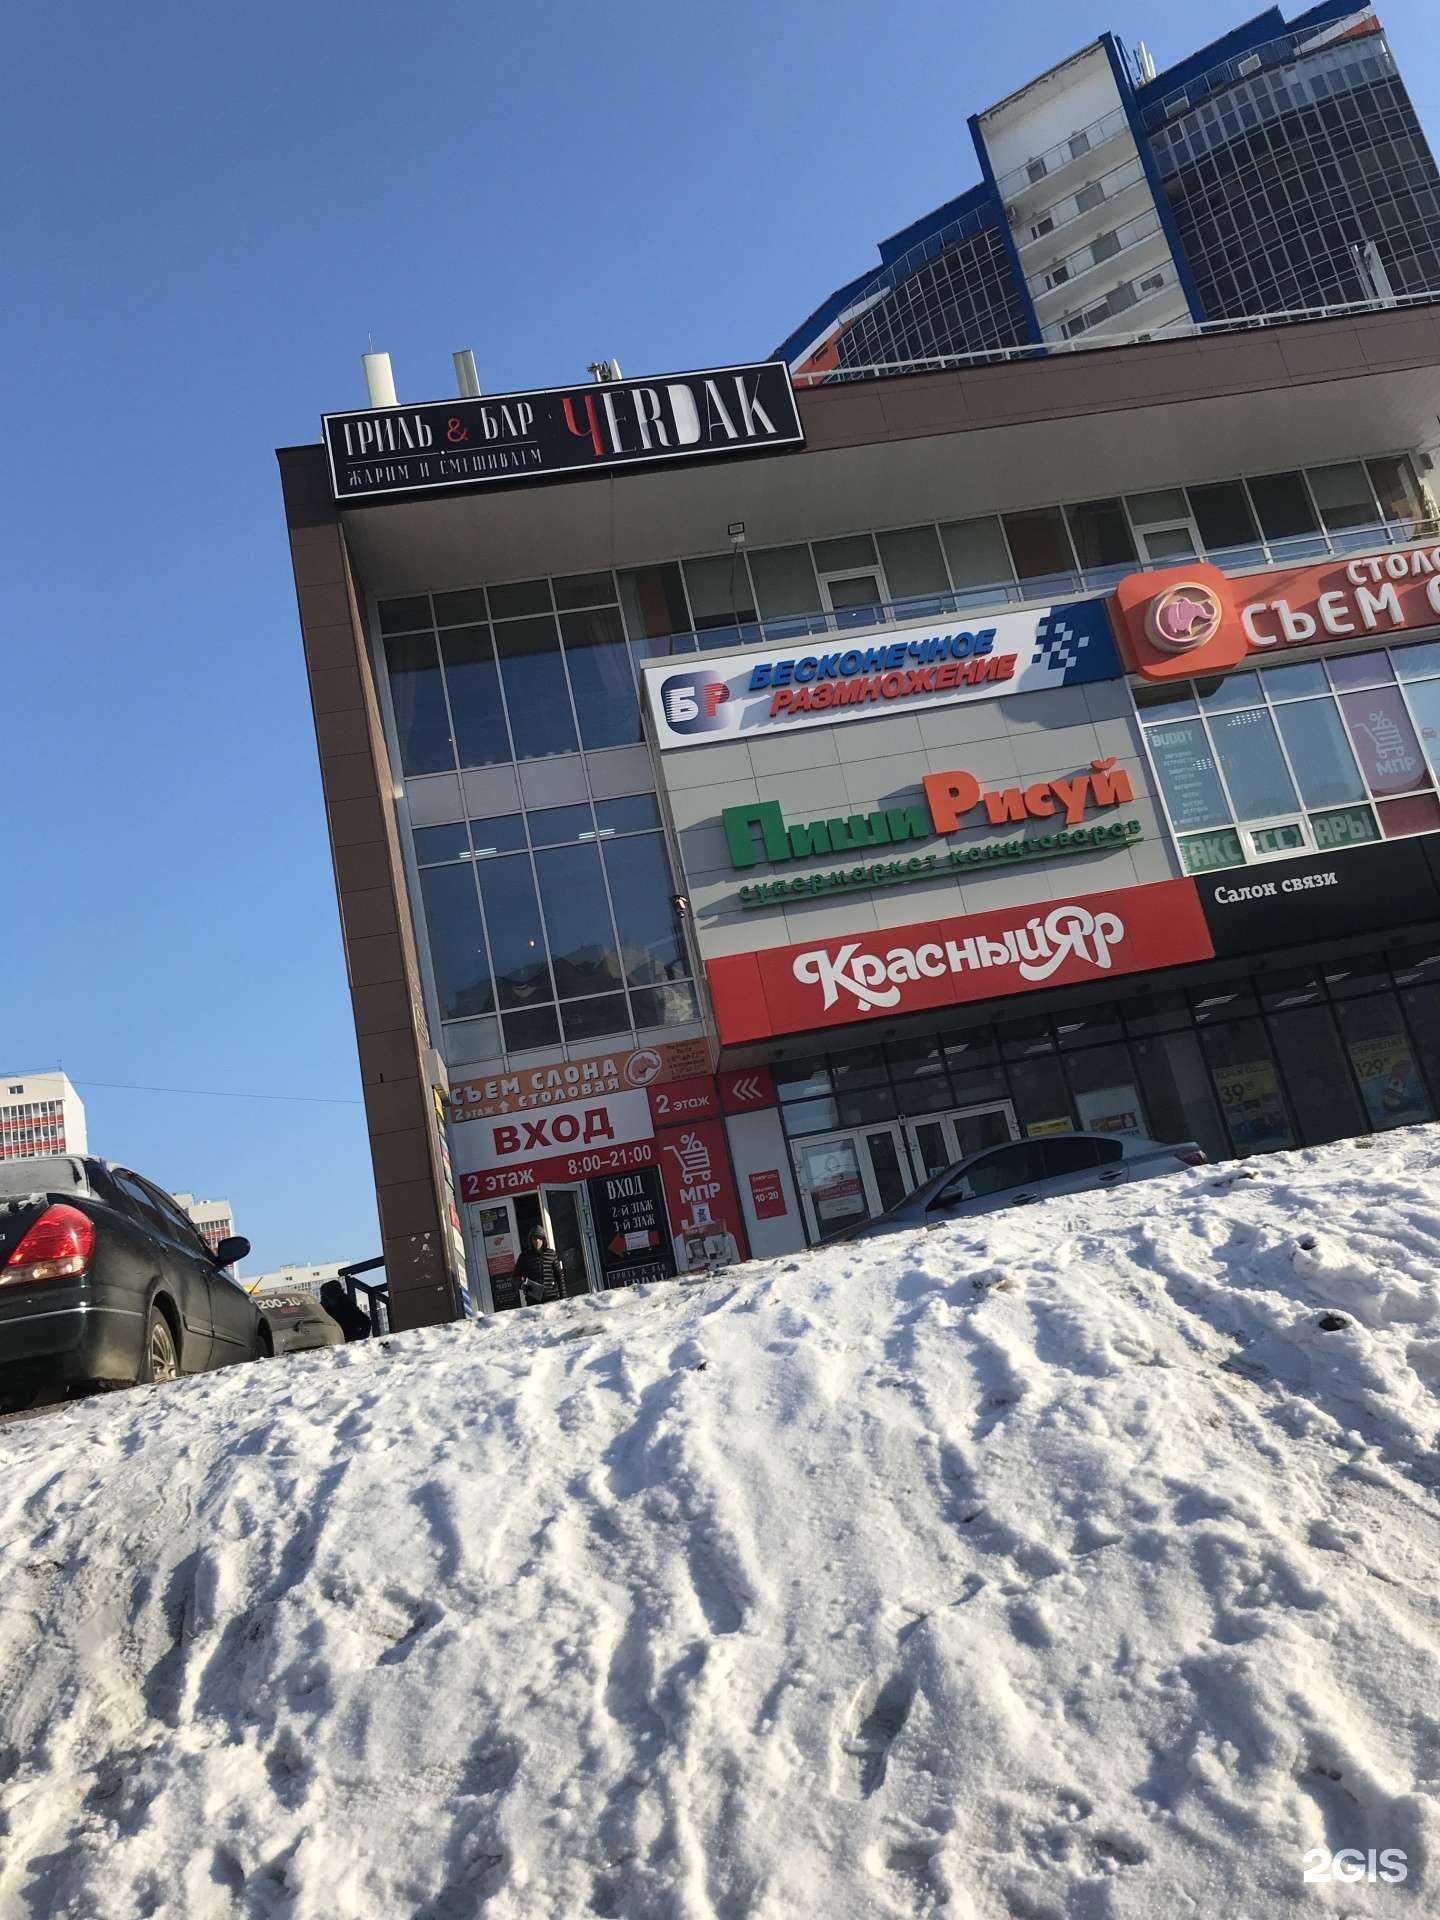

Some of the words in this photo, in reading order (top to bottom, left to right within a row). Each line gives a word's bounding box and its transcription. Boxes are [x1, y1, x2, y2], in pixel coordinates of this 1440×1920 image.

[343, 414, 433, 456] ГРИЛЬ
[447, 417, 470, 442] &
[480, 402, 534, 440] БАР
[347, 464, 409, 486] ЖАРИМ
[419, 462, 430, 478] И
[440, 448, 543, 475] СМЕШИВАЕМ
[1241, 582, 1405, 646] СЪЕМ
[748, 628, 998, 691] БЕСКОНЕЧНОЕ
[665, 682, 731, 722] БР
[769, 653, 1018, 717] РАЗМНОЖЕНИЕ
[1376, 756, 1416, 775] МПР
[739, 853, 937, 903] супермаркет
[950, 820, 1141, 866] канцтоваров
[1214, 882, 1278, 904] Салон
[1281, 872, 1338, 893] связи
[450, 1077, 521, 1105] СЪЕМ
[530, 1059, 618, 1090] СЛОНА
[455, 1108, 464, 1121] 2
[465, 1105, 496, 1118] этаж
[656, 1095, 670, 1114] 2
[674, 1093, 710, 1111] этаж
[492, 1107, 615, 1155] ВХОД
[467, 1174, 479, 1195] 2
[485, 1168, 535, 1191] этаж
[606, 1175, 645, 1200] ВХОД
[679, 1182, 721, 1203] МПР
